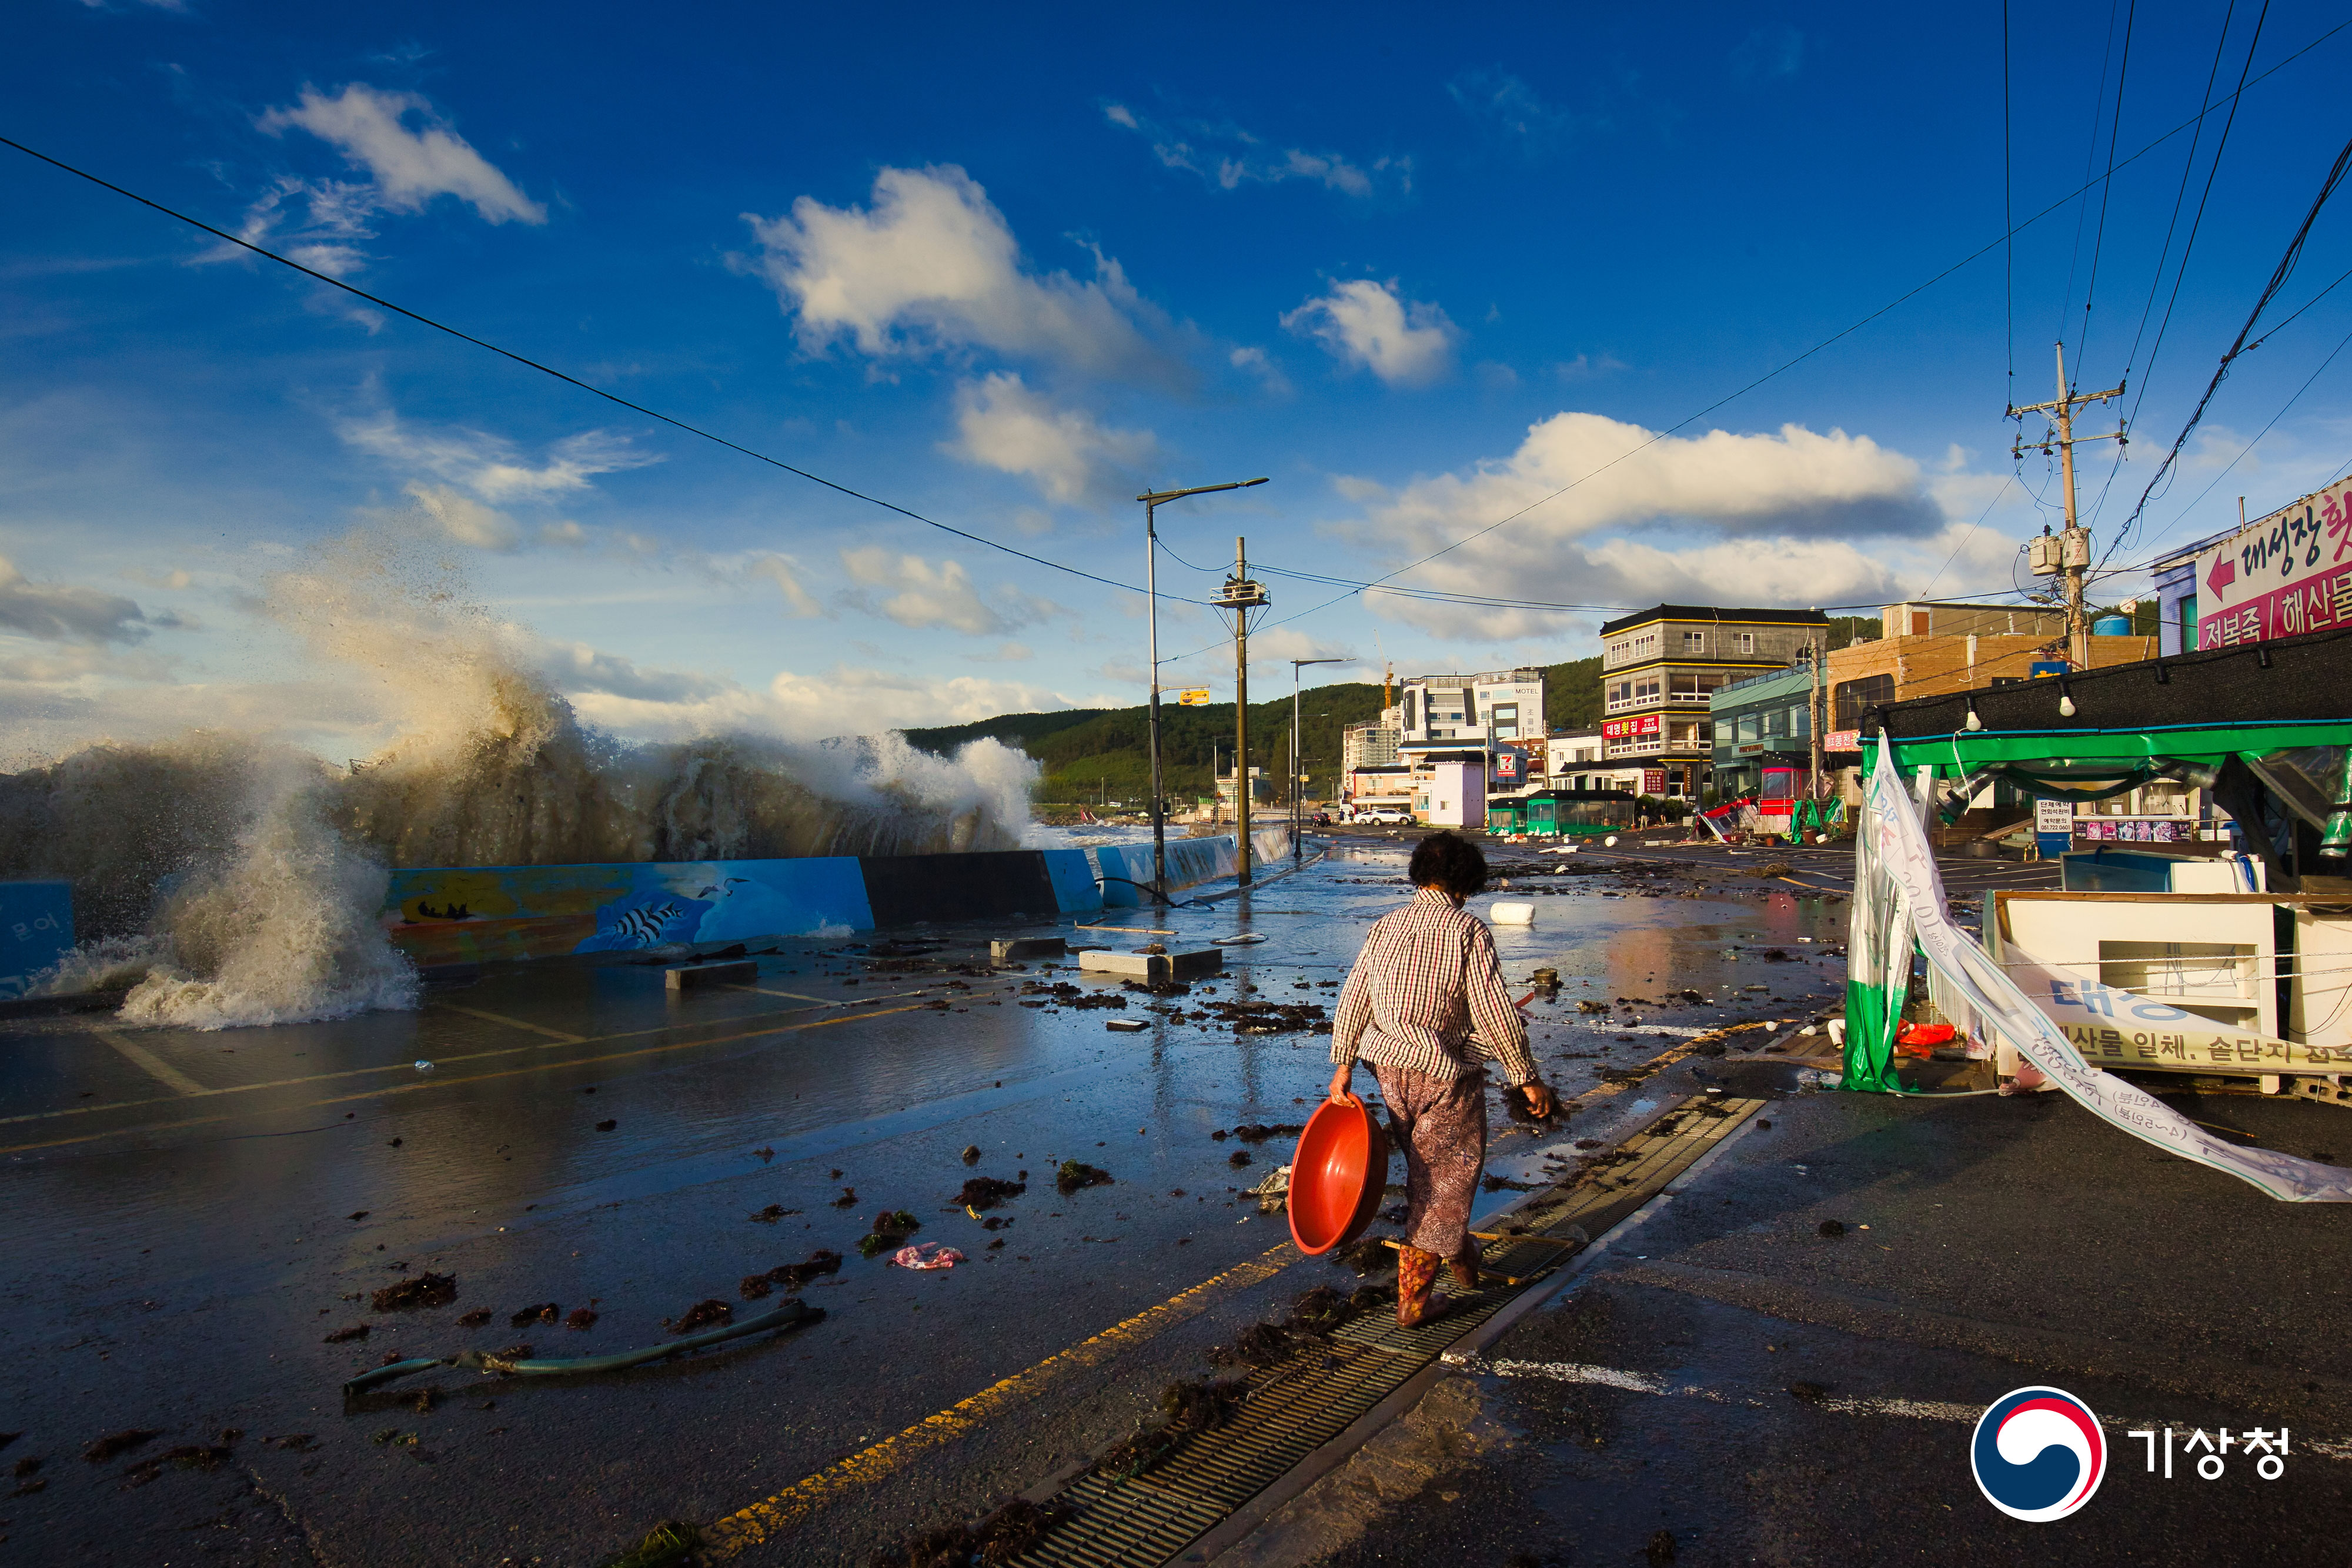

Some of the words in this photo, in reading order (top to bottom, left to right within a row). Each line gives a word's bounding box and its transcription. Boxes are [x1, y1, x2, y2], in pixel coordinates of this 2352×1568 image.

[2241, 506, 2321, 576] 대성장
[2282, 570, 2352, 634] 해산물
[1606, 720, 1638, 736] 대명횟집
[2134, 1027, 2196, 1059] 일체.
[2208, 1036, 2291, 1064] 솥단지
